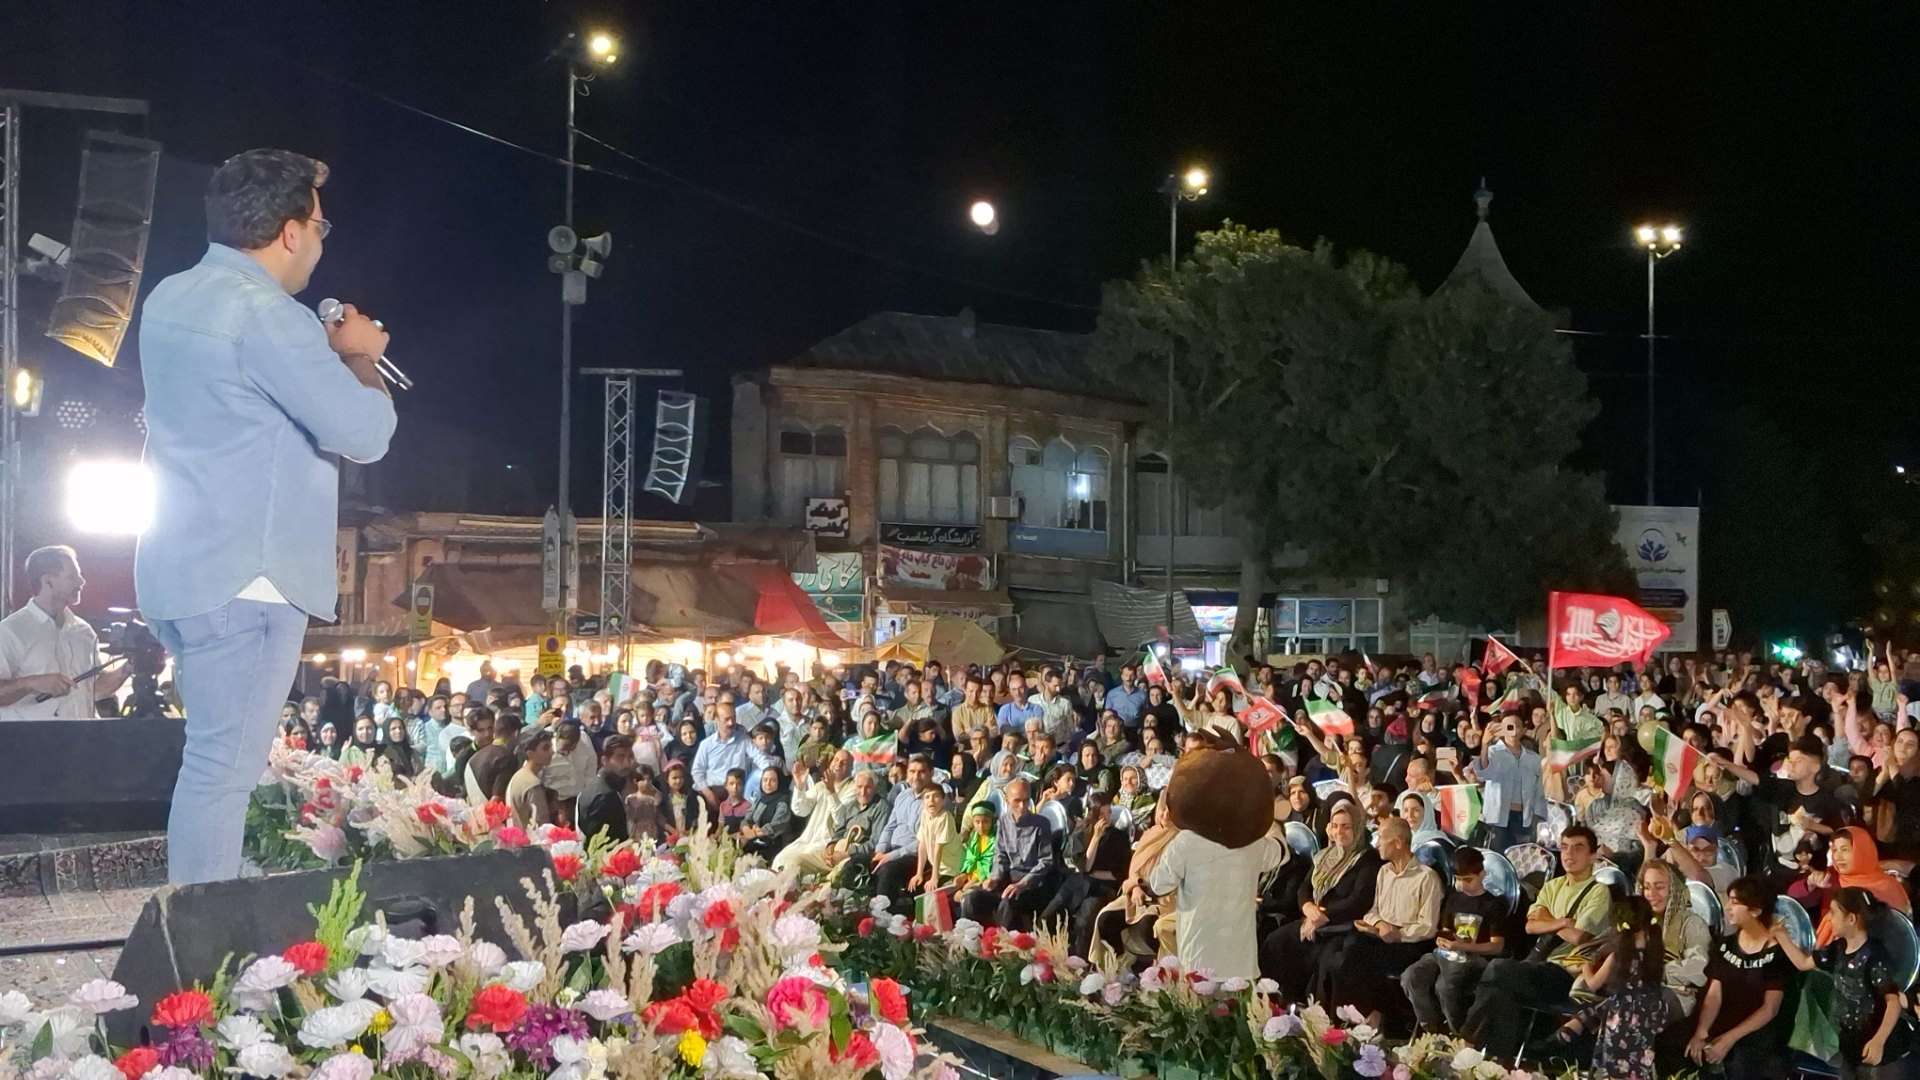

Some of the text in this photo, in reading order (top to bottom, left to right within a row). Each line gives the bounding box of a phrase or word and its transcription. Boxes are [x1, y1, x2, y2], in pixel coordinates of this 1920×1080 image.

[896, 527, 974, 546] آرایشگاه گرشاسب
[818, 553, 861, 592] عکاسی
